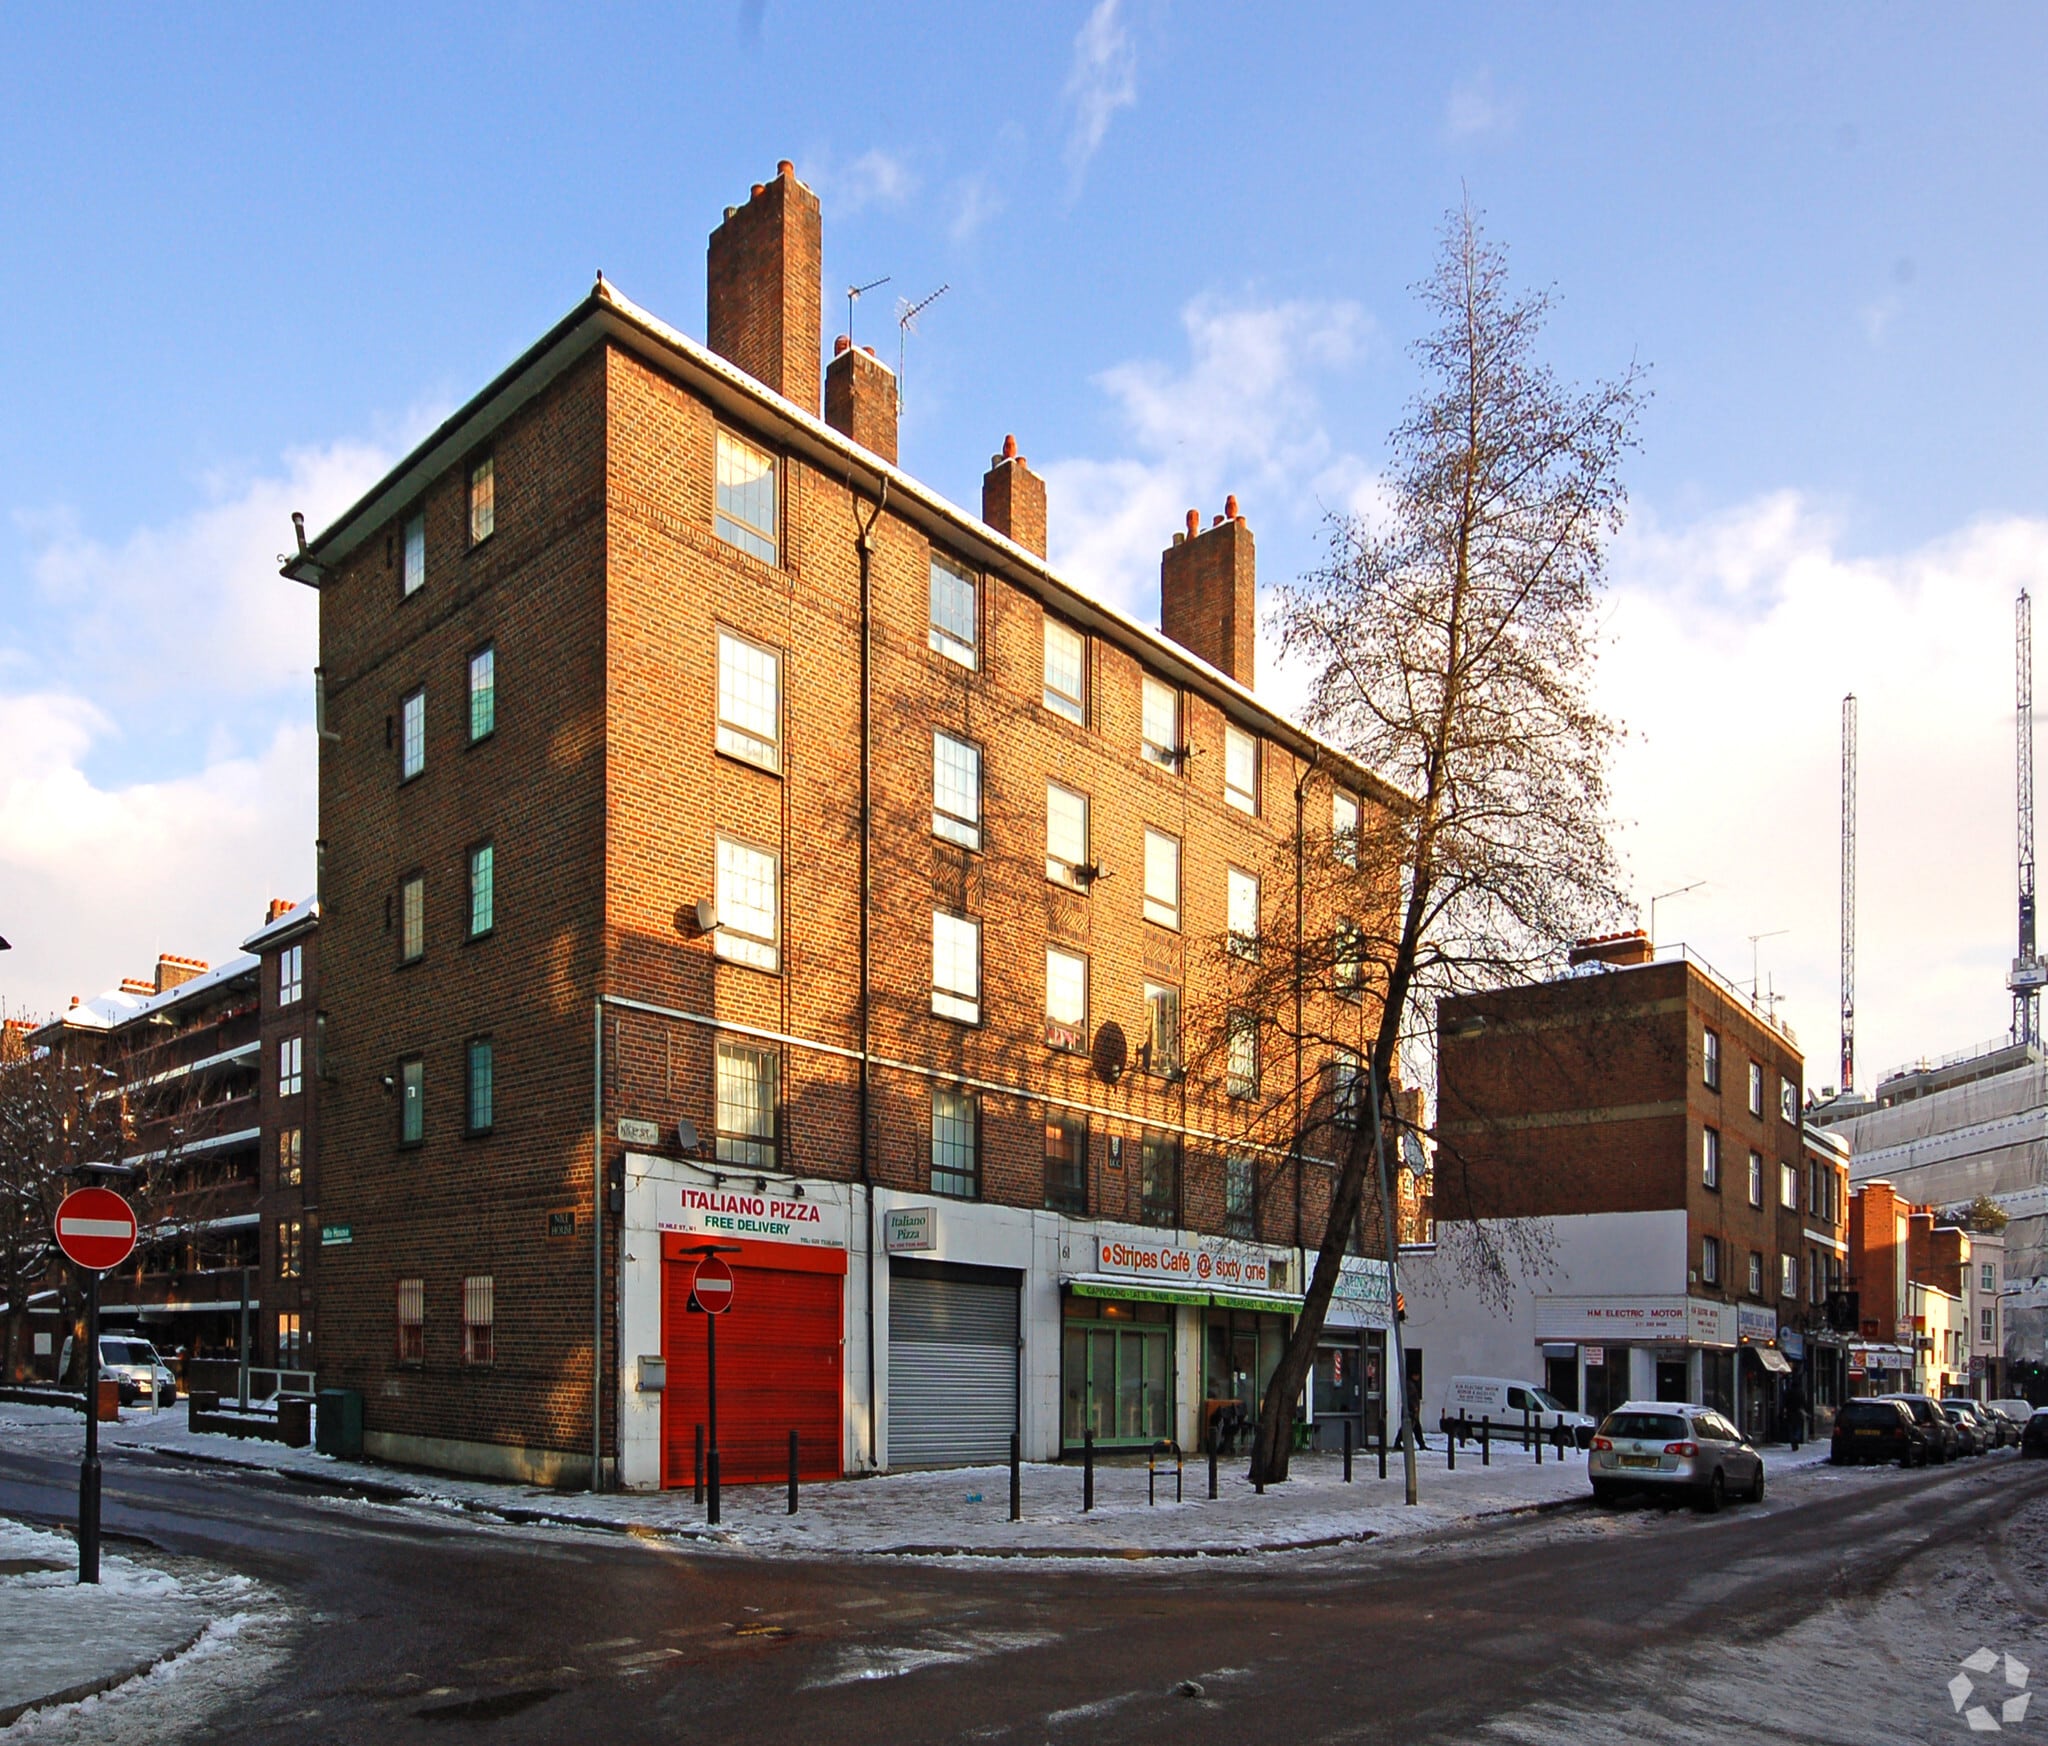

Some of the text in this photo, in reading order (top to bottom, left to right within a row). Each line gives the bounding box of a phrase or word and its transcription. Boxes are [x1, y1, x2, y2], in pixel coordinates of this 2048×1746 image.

[681, 1189, 820, 1222] ITALIANO PIZZA
[705, 1215, 791, 1236] FREE DELIVERY
[891, 1215, 926, 1227] Italiano
[897, 1229, 920, 1240] Pizza
[1112, 1243, 1266, 1283] Stripes Café @ sixty one
[1605, 1309, 1644, 1318] ELECTRIC
[1650, 1309, 1683, 1318] MOTOR
